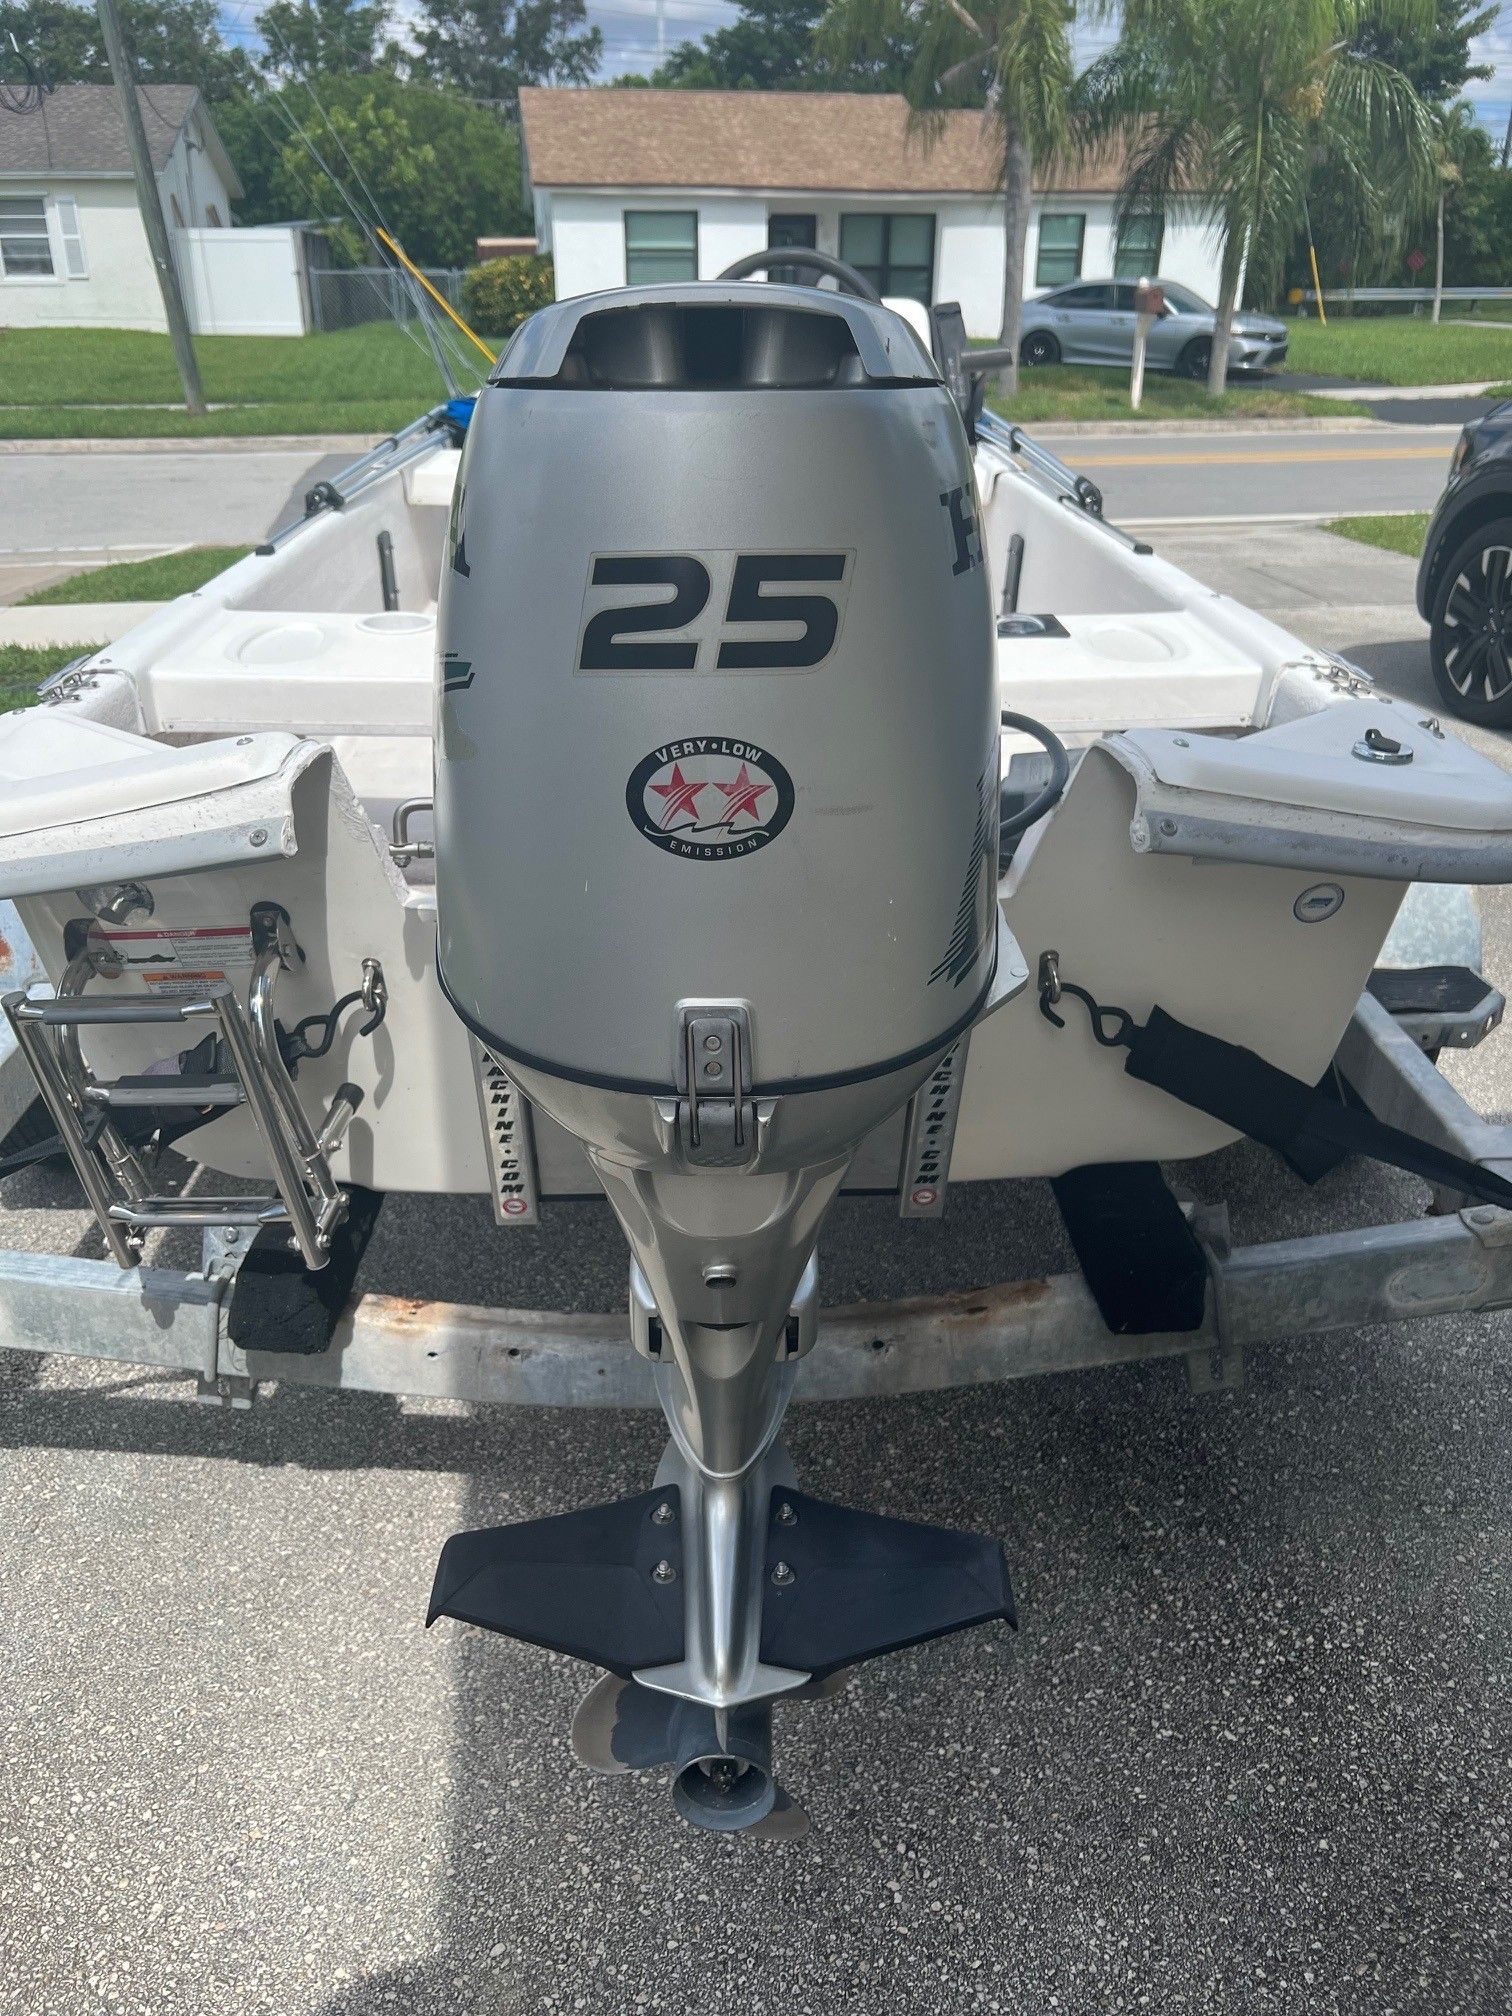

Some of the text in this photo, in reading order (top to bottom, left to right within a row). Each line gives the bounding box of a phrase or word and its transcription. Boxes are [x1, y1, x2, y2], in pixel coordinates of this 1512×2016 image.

[579, 554, 846, 670] 25
[654, 740, 763, 763] VERY LOW
[669, 839, 758, 857] EMISSION
